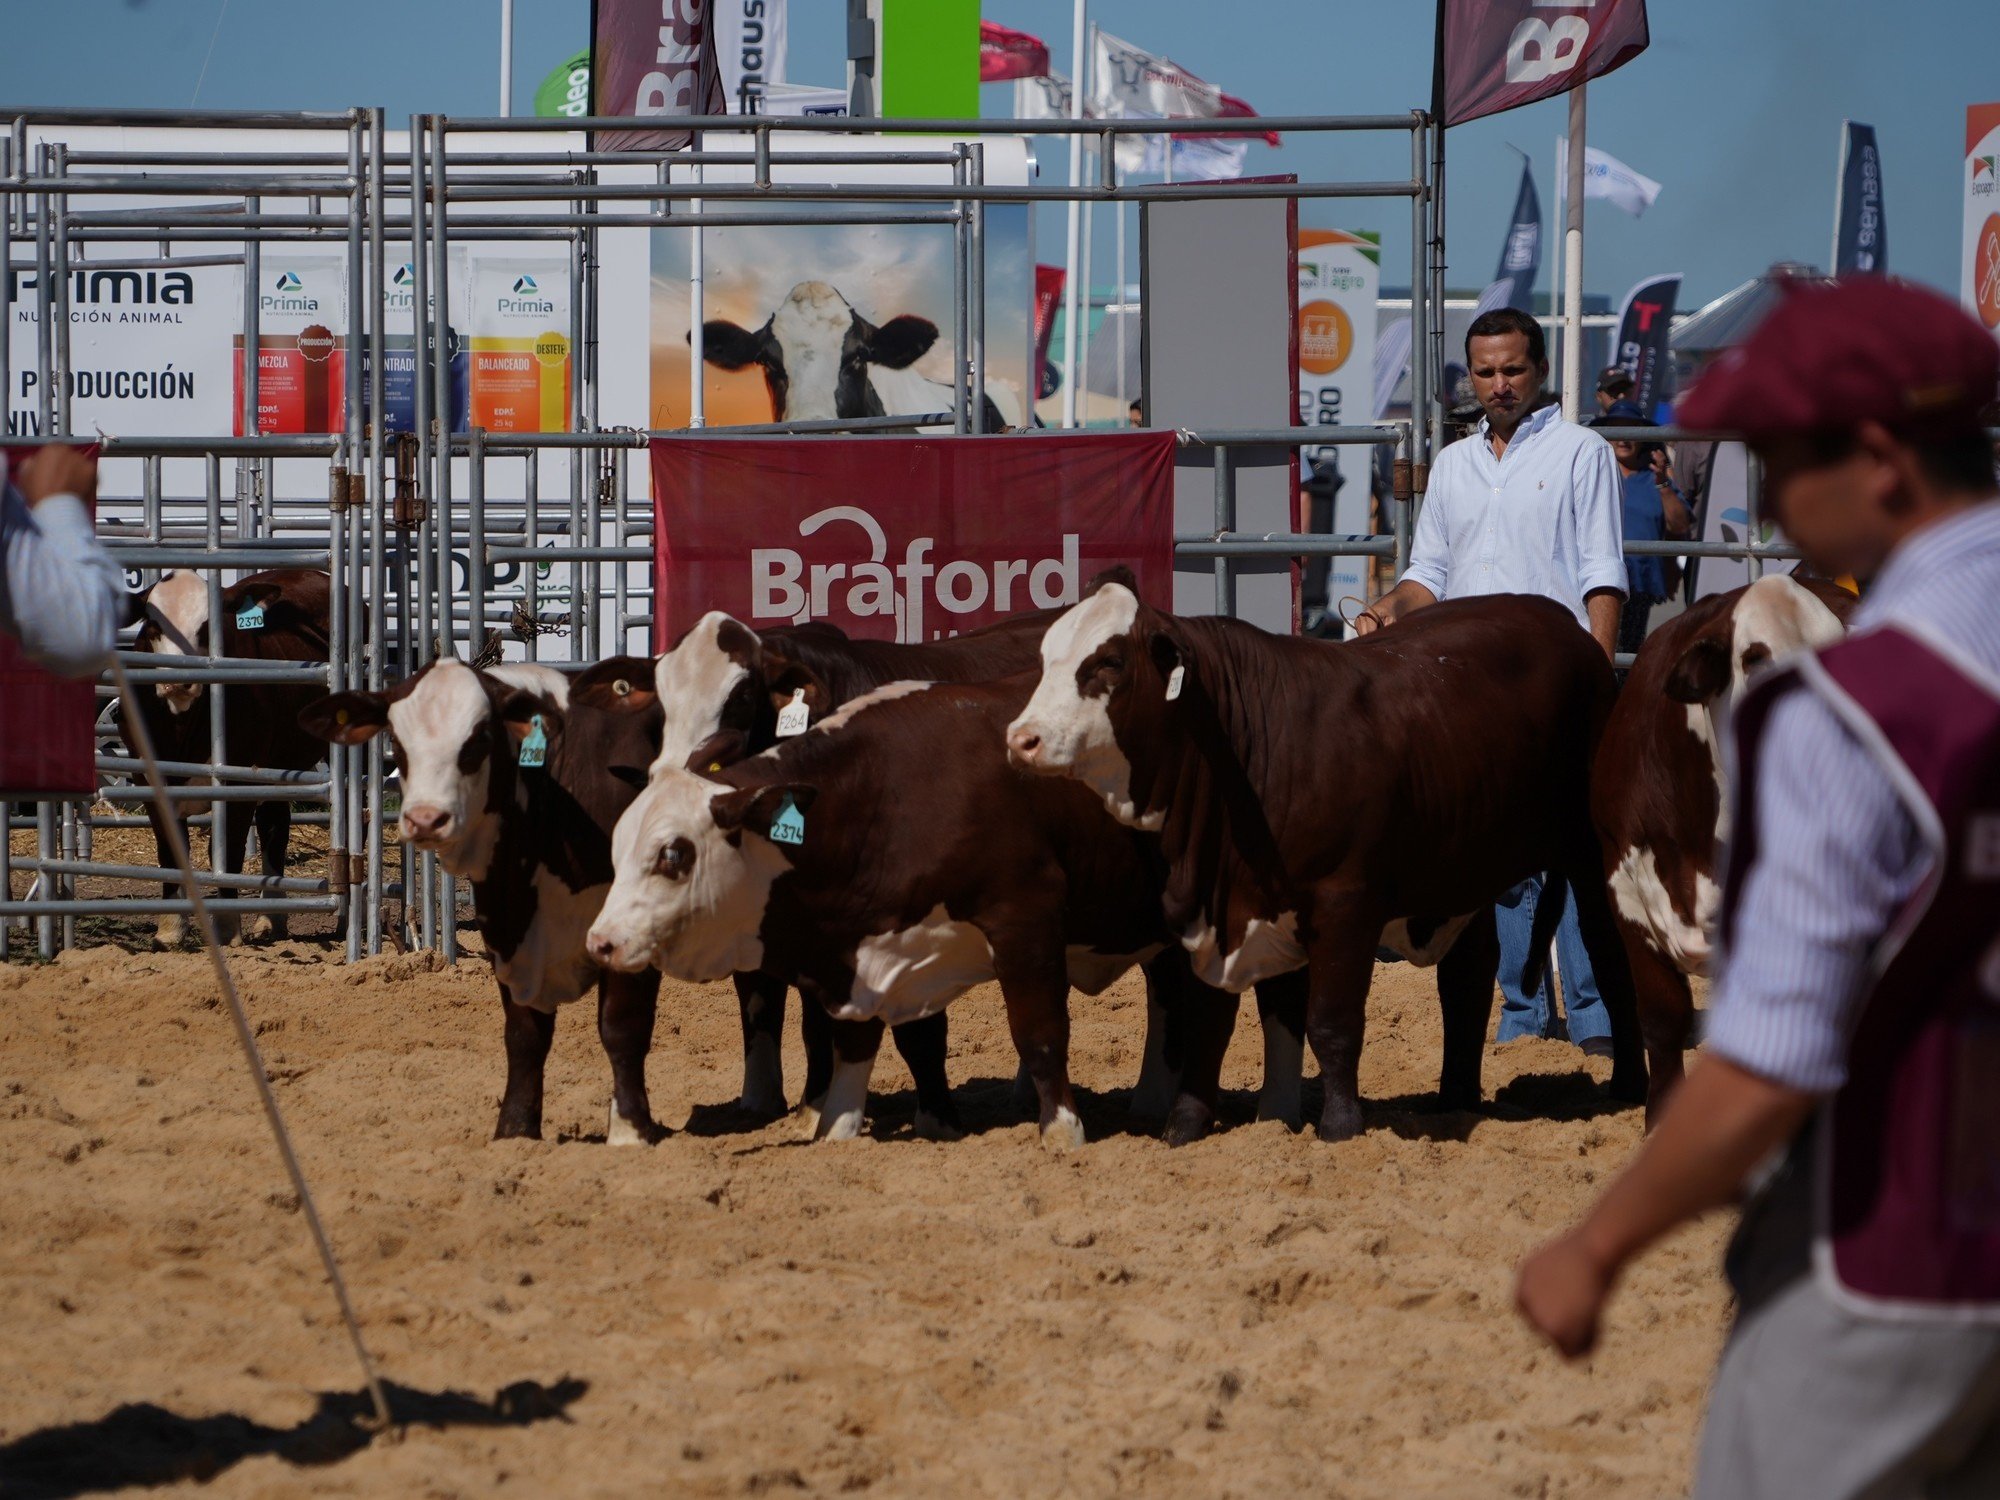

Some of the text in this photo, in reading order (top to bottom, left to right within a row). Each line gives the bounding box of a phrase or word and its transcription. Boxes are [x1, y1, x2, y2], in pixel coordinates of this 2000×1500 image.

[1505, 0, 1597, 83] B
[1857, 145, 1880, 246] senasa
[260, 295, 318, 310] Primia
[498, 298, 553, 312] Primia
[19, 309, 183, 324] NUCIÓN ANIMAL
[301, 337, 332, 346] PRODUCCIÓN
[536, 344, 565, 355] DESTETE
[258, 356, 289, 369] MEZCLA
[479, 359, 530, 371] BALANCEADO
[22, 363, 194, 399] PDUCCIÓN
[258, 416, 277, 426] 25 kg
[752, 533, 1079, 643] Braford
[238, 615, 263, 628] 2370
[780, 713, 806, 729] F264
[772, 822, 803, 842] 2374
